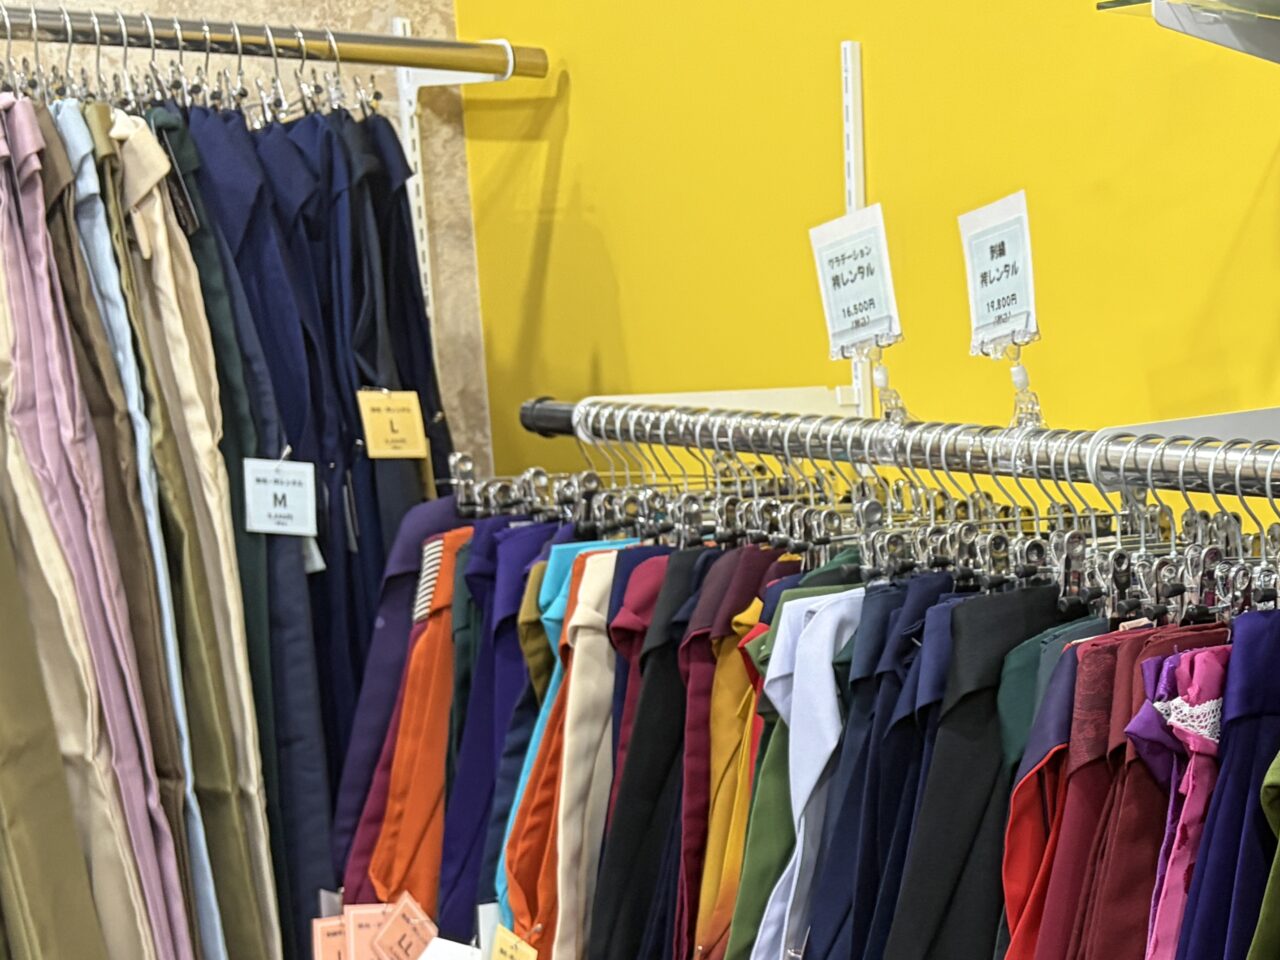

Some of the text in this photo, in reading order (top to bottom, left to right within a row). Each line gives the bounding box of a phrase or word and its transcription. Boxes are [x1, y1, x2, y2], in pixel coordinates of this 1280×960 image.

[831, 262, 875, 291] 袴レンタル
[980, 261, 1019, 288] 袴レンタル
[389, 419, 399, 433] L
[273, 493, 287, 508] M
